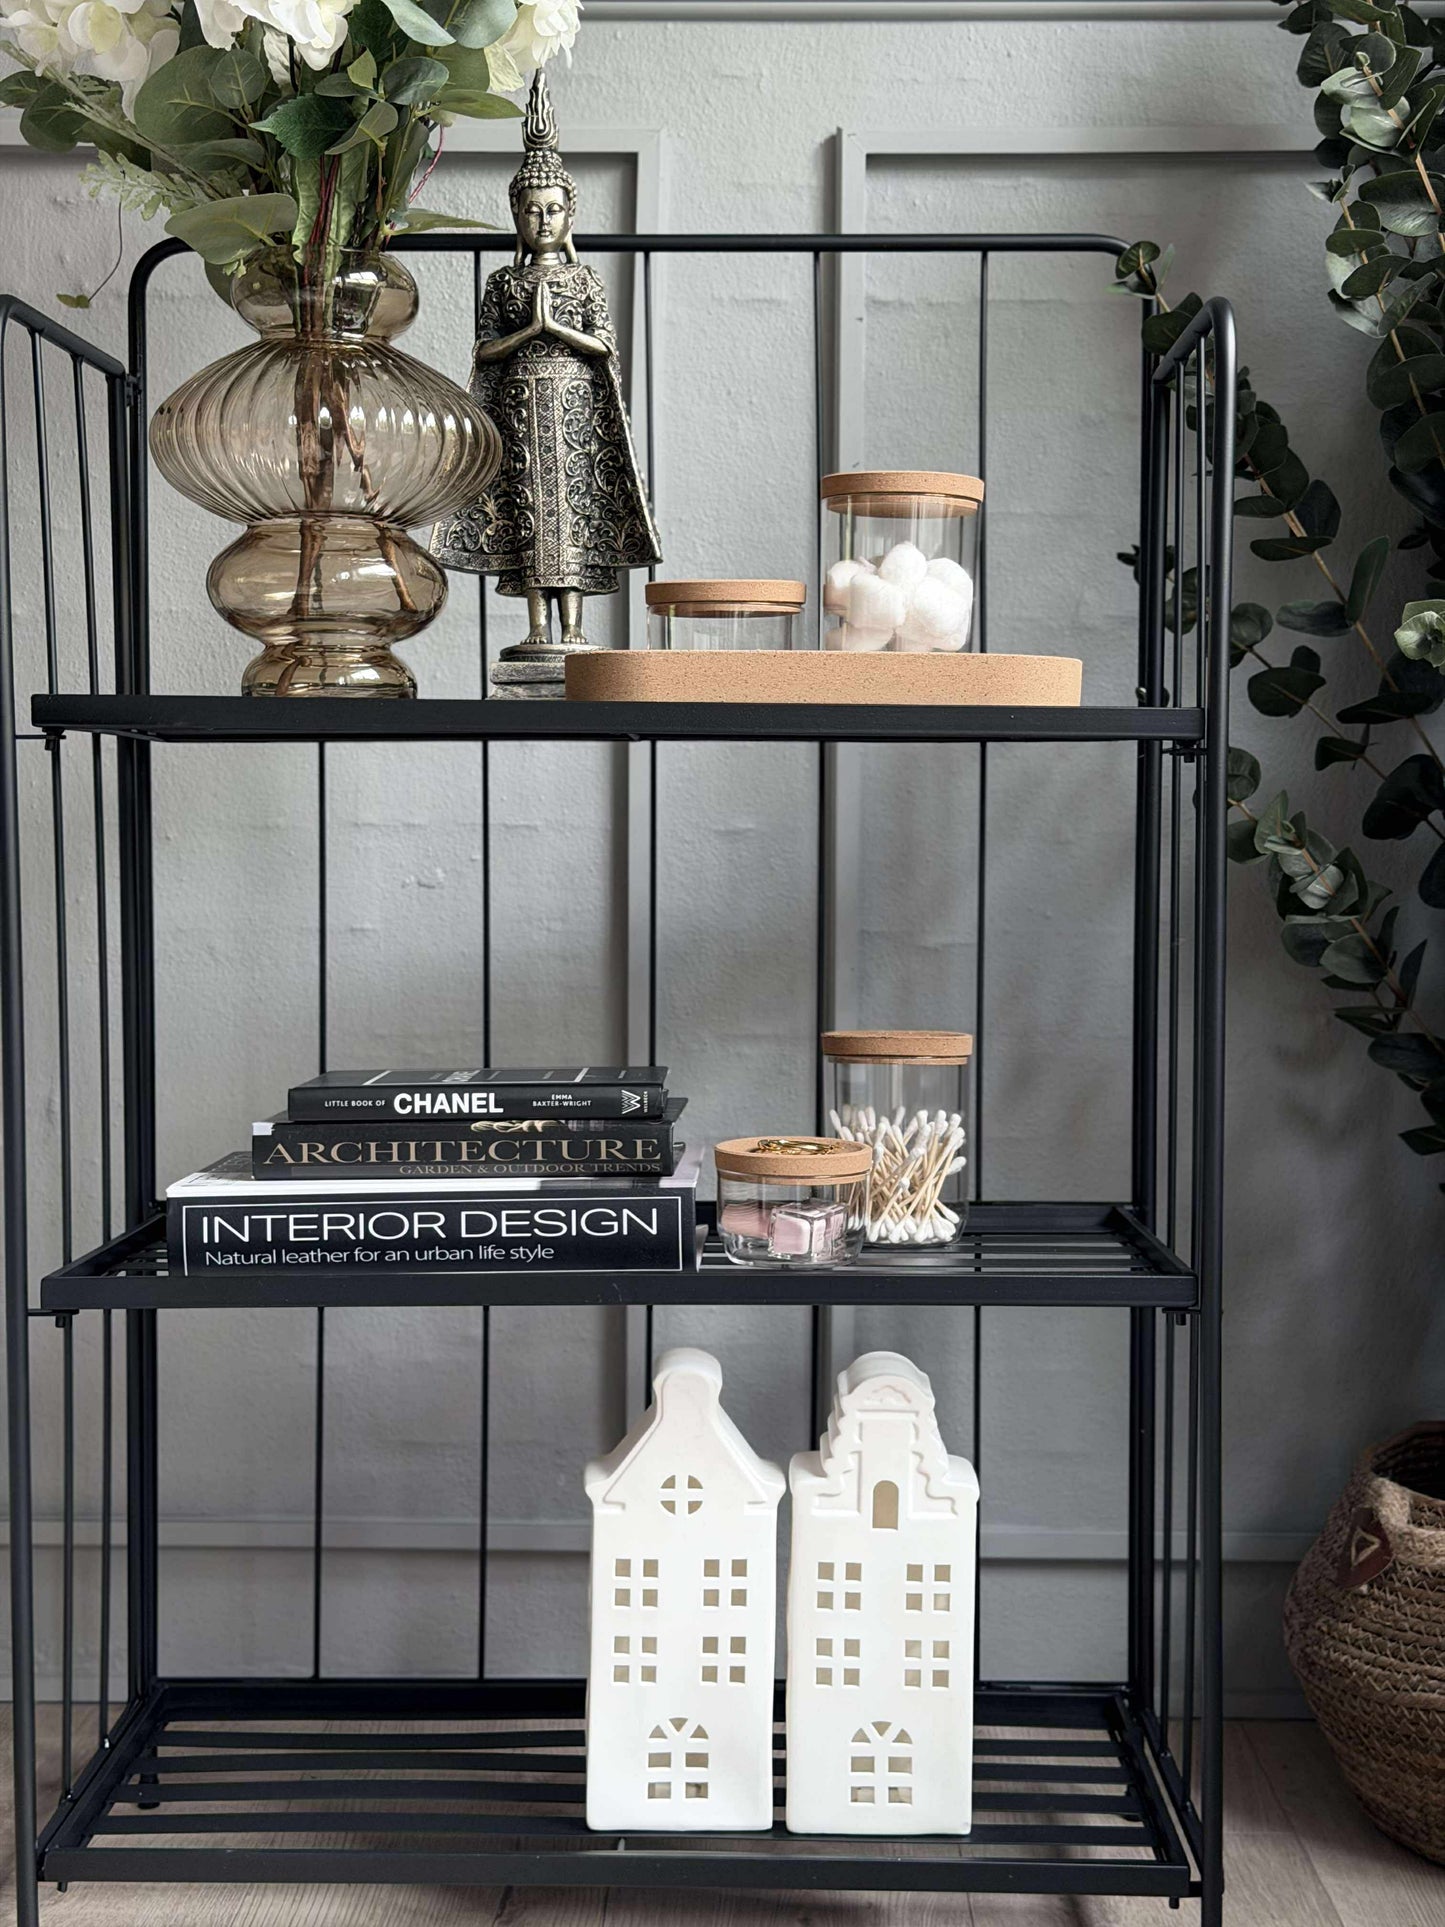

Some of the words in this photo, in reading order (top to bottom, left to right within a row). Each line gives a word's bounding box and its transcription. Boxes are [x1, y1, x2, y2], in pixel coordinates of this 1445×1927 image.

[393, 1092, 504, 1114] CHANEL
[263, 1138, 661, 1165] ARCHITECTURE
[399, 1164, 473, 1175] GARDEN
[477, 1163, 489, 1173] &
[493, 1163, 585, 1174] OUTDOOR
[589, 1162, 661, 1173] TRENDS
[202, 1211, 447, 1244] INTERIOR
[460, 1207, 658, 1238] DESIGN
[205, 1249, 276, 1265] Natural
[282, 1248, 350, 1264] leather
[354, 1247, 381, 1262] for
[385, 1250, 410, 1262] an
[415, 1246, 474, 1261] urban
[478, 1244, 506, 1260] life
[510, 1244, 554, 1263] style
